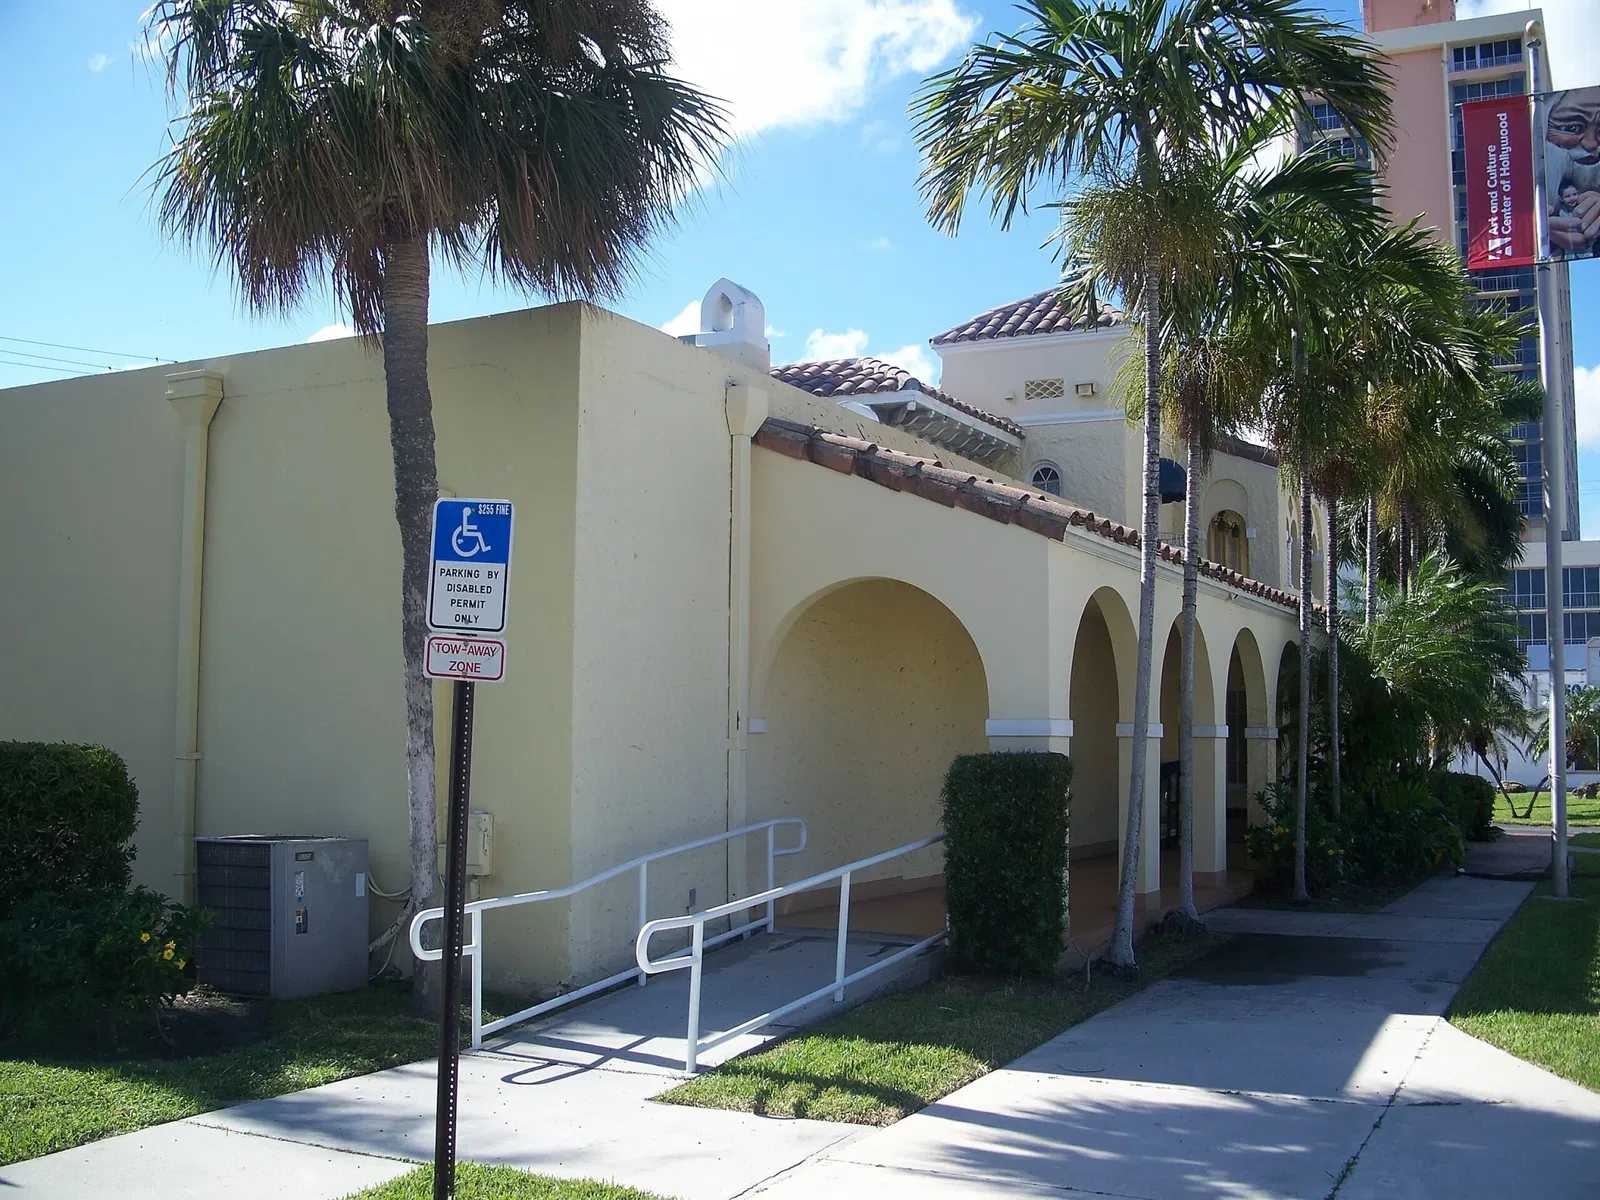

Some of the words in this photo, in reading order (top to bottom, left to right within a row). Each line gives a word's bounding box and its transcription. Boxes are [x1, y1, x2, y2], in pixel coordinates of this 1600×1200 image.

[1497, 113, 1512, 176] Hollywood
[1487, 145, 1498, 188] Culture
[1500, 179, 1511, 192] of
[1488, 191, 1498, 214] and
[1501, 196, 1512, 234] Center
[1488, 216, 1498, 235] Art
[496, 504, 510, 516] FINE
[440, 568, 480, 579] PARKING
[487, 570, 499, 580] BY
[446, 584, 492, 594] DISABLED
[450, 599, 486, 609] PERMIT
[454, 614, 479, 624] ONLY
[435, 643, 497, 657] TOW-AWAY
[449, 660, 481, 673] ZONE
